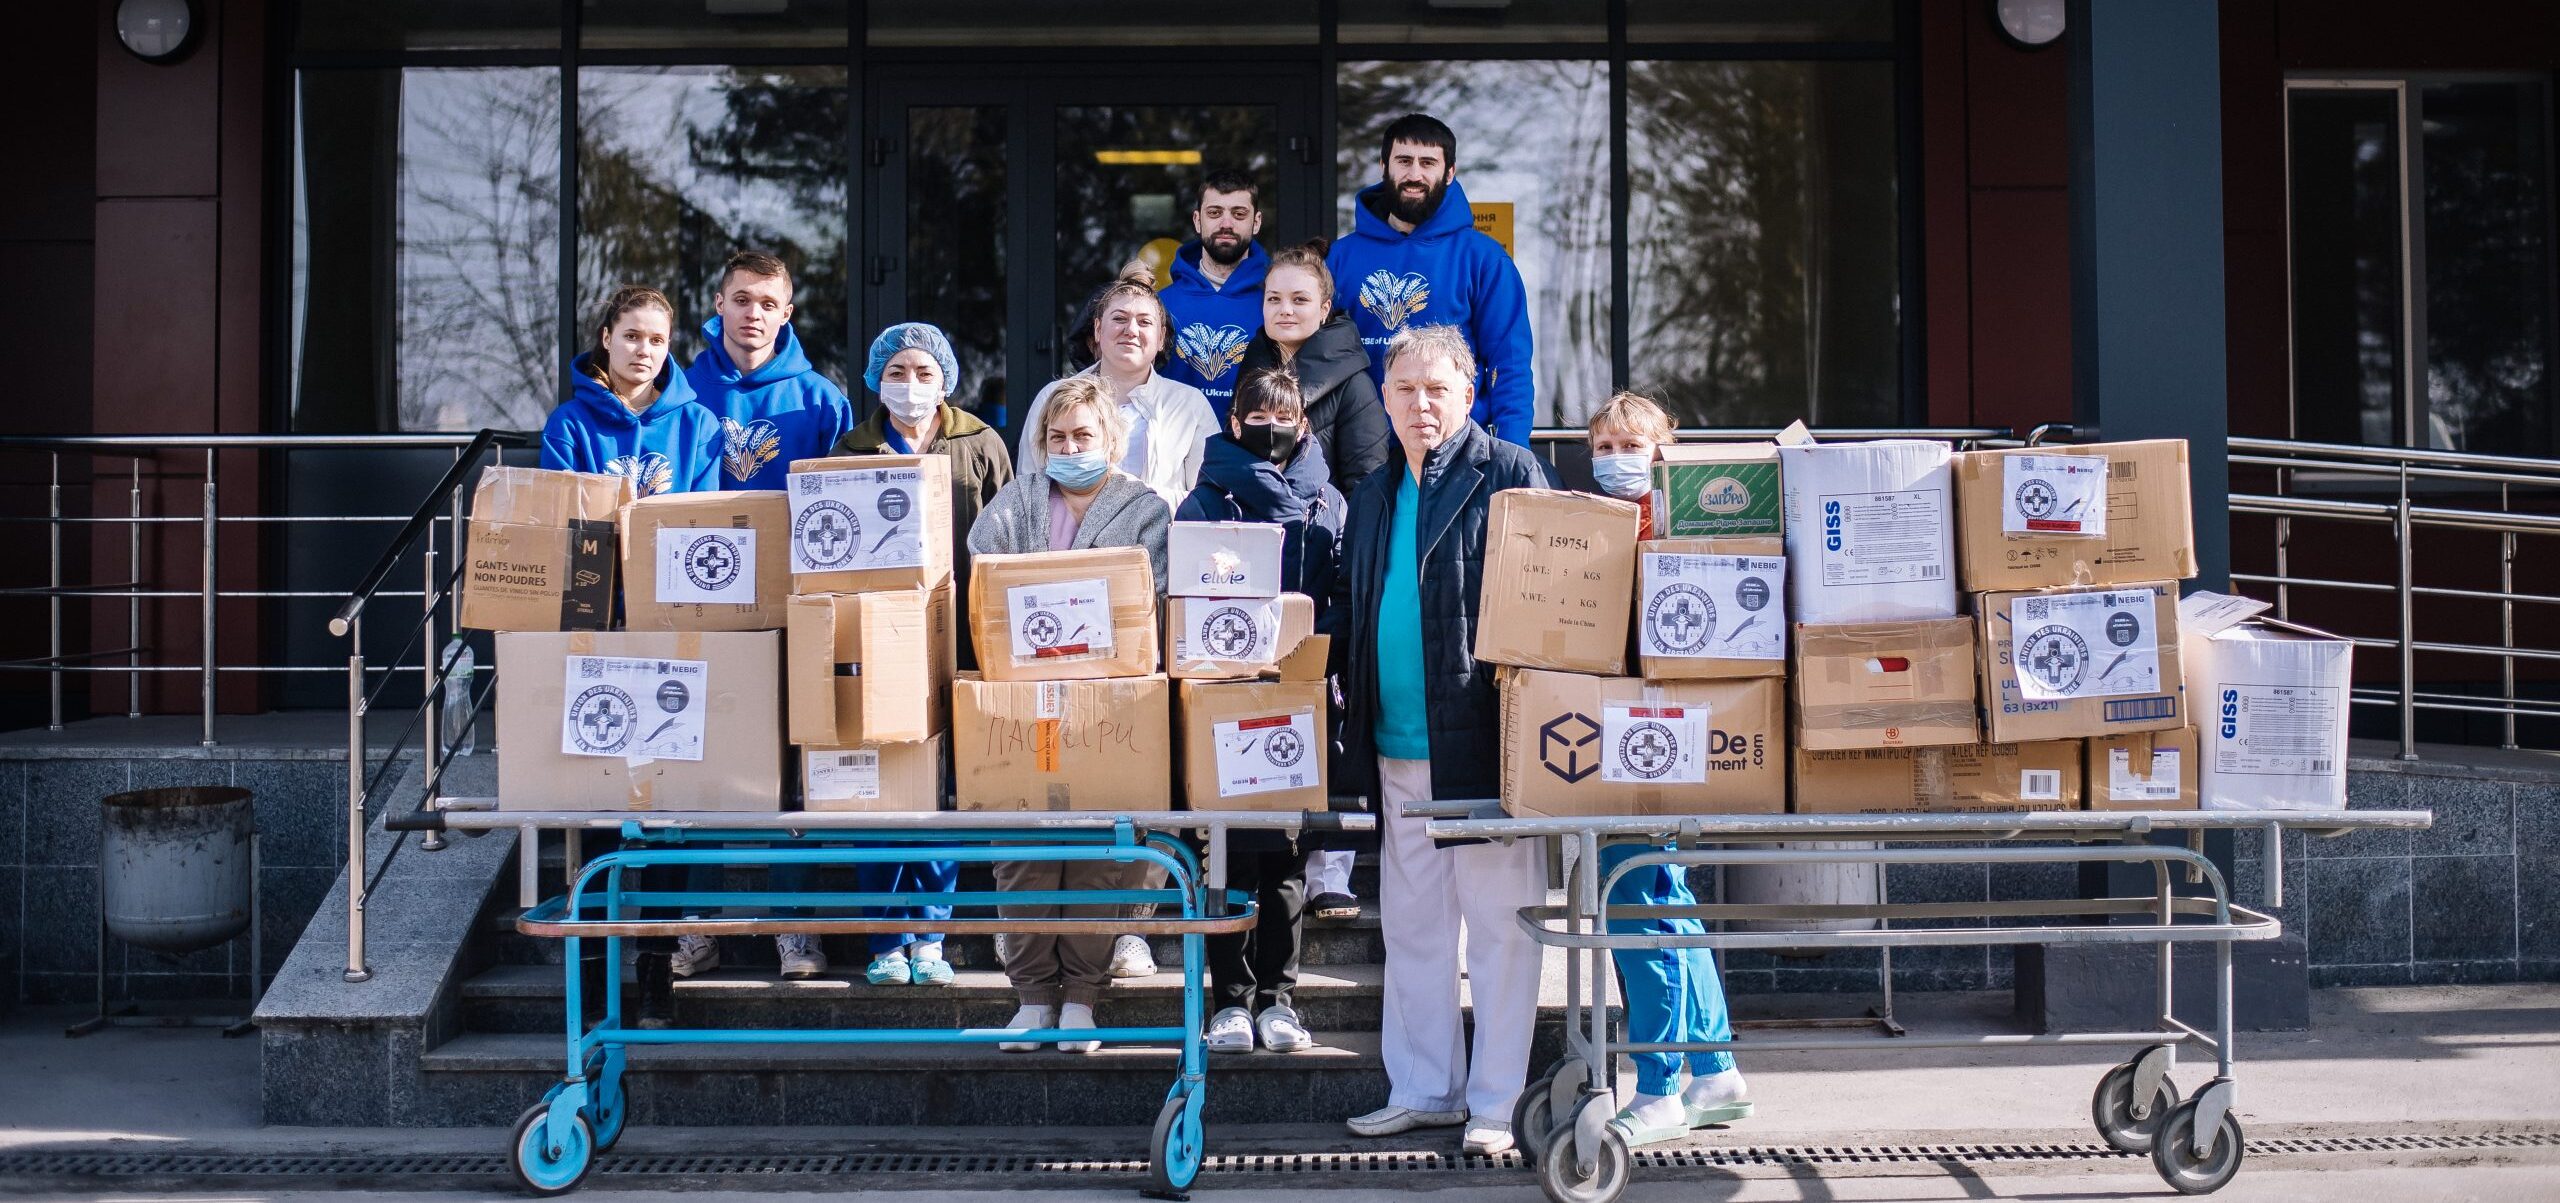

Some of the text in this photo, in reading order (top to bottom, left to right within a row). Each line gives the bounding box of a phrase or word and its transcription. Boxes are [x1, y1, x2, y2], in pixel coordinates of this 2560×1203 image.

[1474, 213, 1496, 222] ННЯ
[890, 472, 916, 480] NEBIG
[1705, 492, 1744, 506] ЗАГОРА
[795, 500, 860, 535] UNION DES UKRAINIENS
[1825, 500, 1842, 552] GISS
[582, 539, 598, 556] M
[1549, 535, 1589, 551] 159754
[475, 559, 547, 574] GANTS VINYLE
[1750, 561, 1778, 570] NEBIG
[474, 572, 547, 587] NON POUDRES
[1563, 568, 1568, 577] 5
[1583, 570, 1601, 581] KGS
[473, 584, 499, 593] GUANTES
[1560, 598, 1565, 606] 4
[1580, 598, 1597, 609] KGS
[1647, 583, 1716, 618] UNION DES UKRAINIENS
[2117, 595, 2145, 604] NEBIG
[1558, 617, 1573, 626] Made
[1579, 619, 1596, 628] China
[2020, 625, 2088, 662] UNION DES UKRAINIENS
[671, 665, 699, 674] NEBIG
[2001, 679, 2018, 689] UL
[571, 693, 589, 717] UNION
[588, 686, 603, 698] DES
[2002, 692, 2010, 701] L
[2003, 700, 2059, 714] 63 (3x21)
[2221, 689, 2238, 739] GISS
[1650, 722, 1672, 739] UNION
[1708, 729, 1747, 754] De
[1754, 733, 1764, 770] .com
[1975, 742, 1988, 757] REF
[1706, 757, 1747, 771] ment
